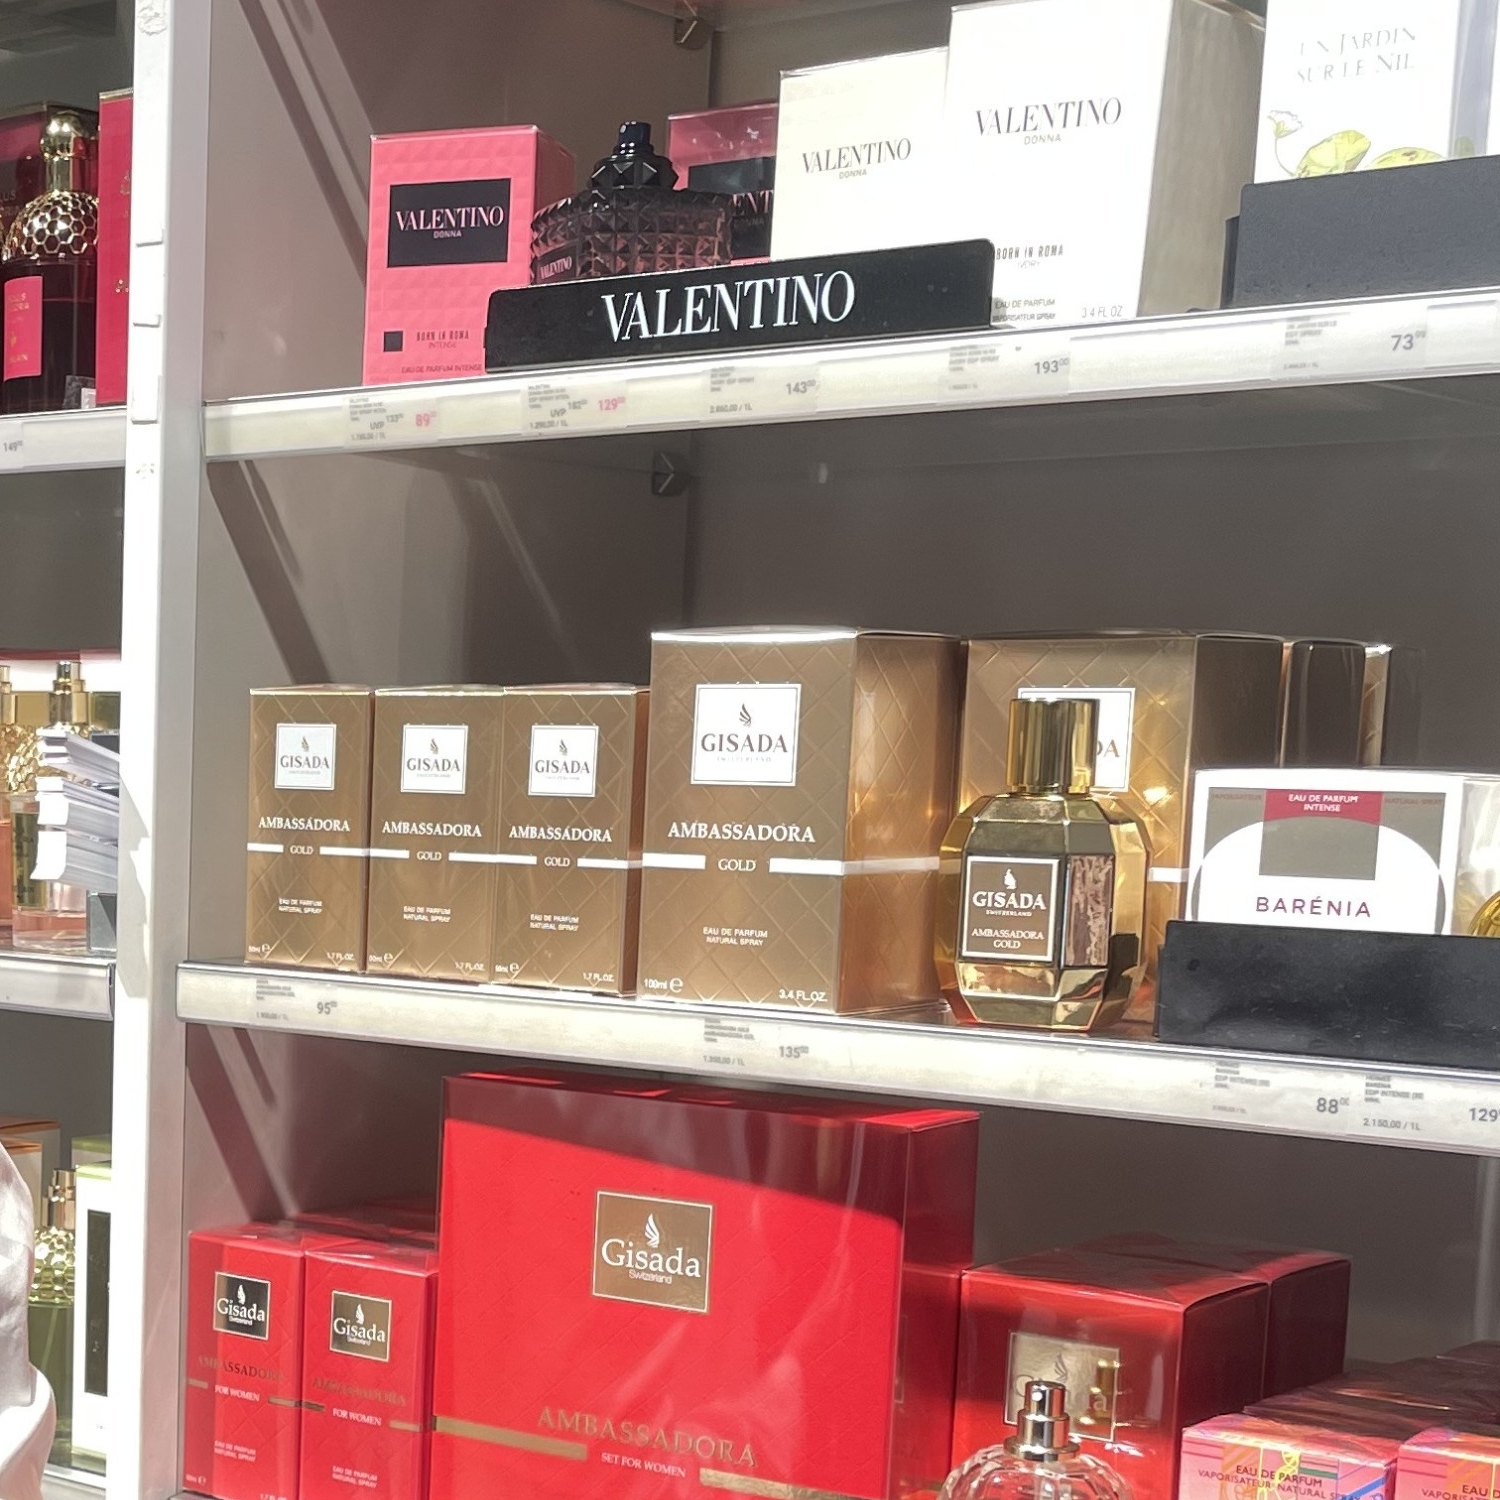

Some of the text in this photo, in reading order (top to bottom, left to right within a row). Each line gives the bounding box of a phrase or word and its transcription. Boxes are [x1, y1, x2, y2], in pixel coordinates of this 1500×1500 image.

[976, 97, 1122, 137] VALENTINO
[1024, 133, 1061, 145] DONNA
[802, 138, 911, 174] VALENTINO
[838, 169, 867, 179] DONNA
[396, 206, 504, 231] VALENTINO
[433, 230, 462, 239] DONNA
[996, 248, 1020, 260] BORN
[1038, 245, 1064, 257] ROMA
[601, 270, 855, 342] VALENTINO
[417, 331, 435, 342] BORN
[449, 330, 469, 340] ROMA
[700, 732, 788, 754] GISADA
[280, 755, 330, 769] GISADA
[406, 757, 461, 773] GISADA
[535, 760, 590, 775] GISADA
[1289, 793, 1359, 804] EAU DE PARFUM
[1303, 803, 1341, 813] INTENSE
[258, 817, 350, 832] AMBASSADORA
[382, 820, 482, 837] AMBASSADORA
[509, 826, 613, 843] AMBASSADORA
[667, 822, 816, 843] AMBASSADORA
[290, 845, 314, 855] GOLD
[417, 851, 442, 861] GOLD
[544, 857, 571, 867] GOLD
[718, 858, 757, 872] GOLD
[972, 891, 1047, 910] GISADA
[1256, 896, 1371, 917] BARÉNIA
[703, 927, 768, 938] EAU DE PARFUM
[971, 928, 1044, 940] AMBASSADORA
[706, 936, 764, 947] NATURAL SPRAY
[993, 940, 1021, 949] GOLD
[644, 978, 668, 990] 100ml
[779, 989, 794, 999] 3.4
[1469, 1107, 1500, 1122] 129
[601, 1238, 701, 1278] Gisada
[217, 1298, 265, 1322] Gisada
[333, 1318, 386, 1342] Gisada
[215, 1386, 260, 1401] FOR WOMEN
[332, 1408, 382, 1426] FOR WOMEN
[538, 1406, 756, 1467] AMBASSADORA
[601, 1452, 686, 1478] SET FOR WOMEN
[1199, 1469, 1271, 1489] VAPORISATEUR
[1277, 1483, 1328, 1499] NATURAL
[1236, 1465, 1323, 1488] EAU DE PARFUM
[1462, 1484, 1488, 1496] EAU
